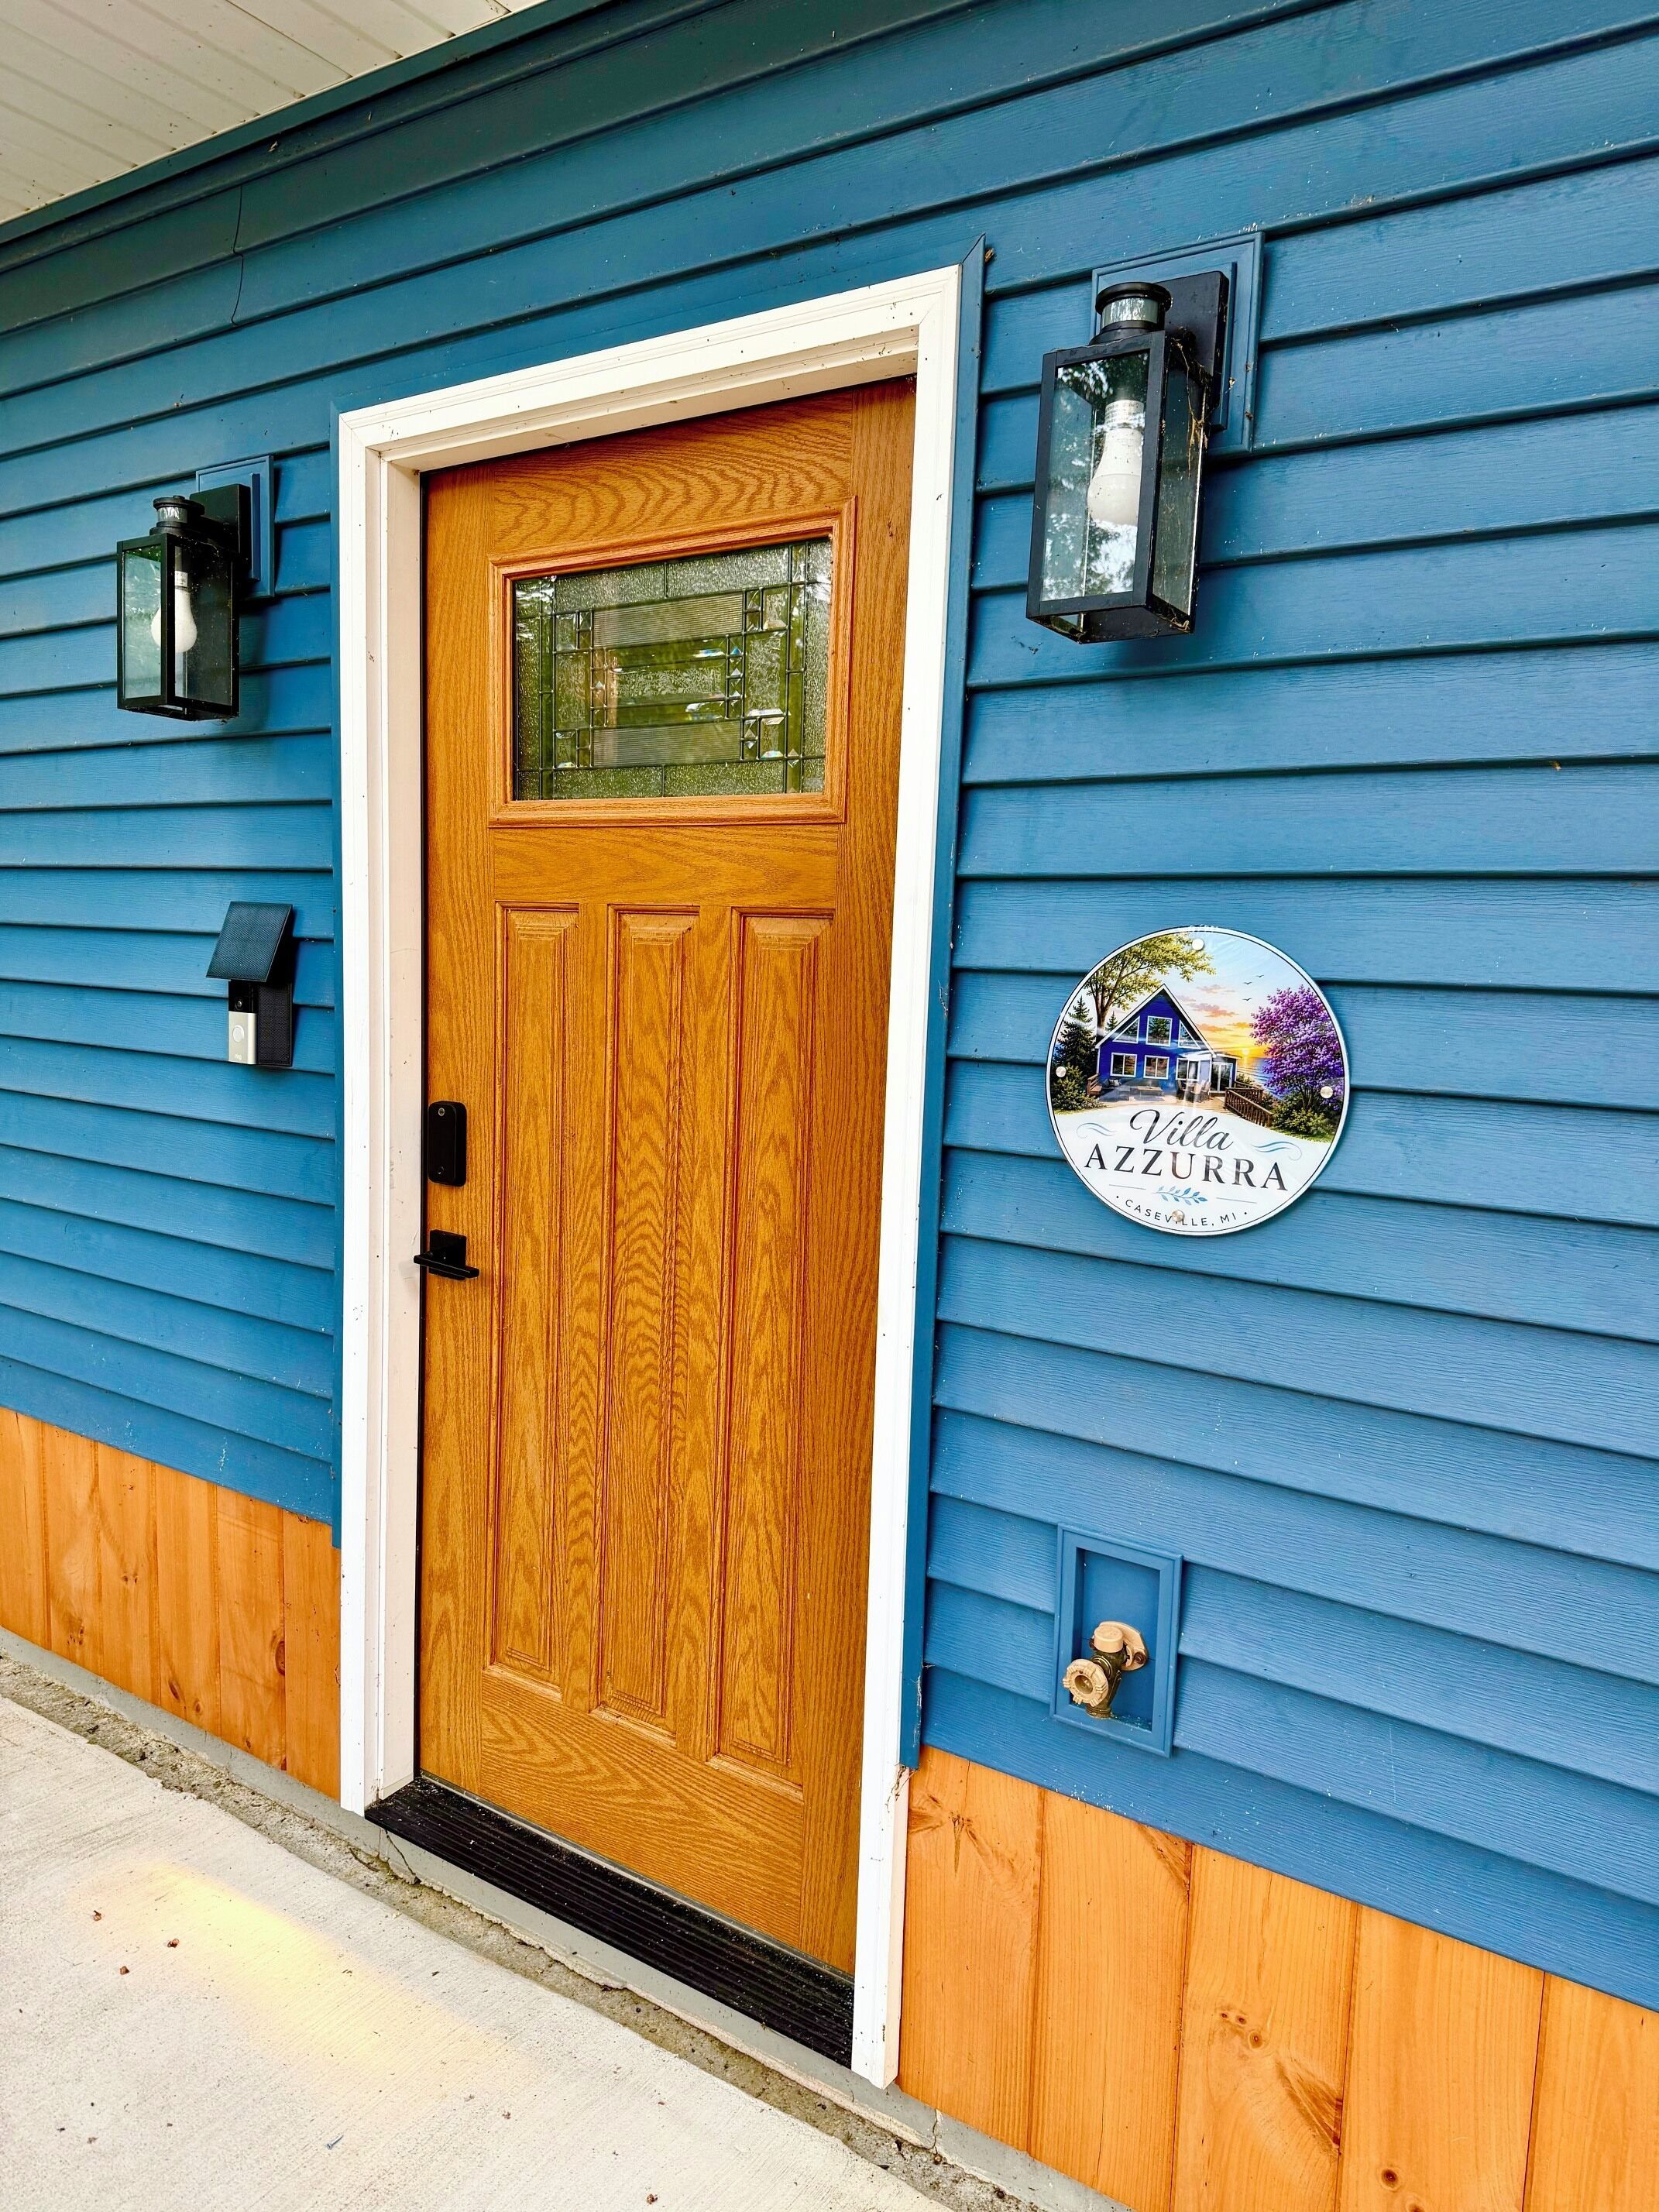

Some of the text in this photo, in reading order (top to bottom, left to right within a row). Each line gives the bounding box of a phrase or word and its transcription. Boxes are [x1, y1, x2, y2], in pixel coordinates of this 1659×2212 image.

[1129, 1108, 1233, 1150] Villa
[1084, 1143, 1288, 1191] AZZURRA
[1125, 1199, 1237, 1227] CASEVLLE, MI
